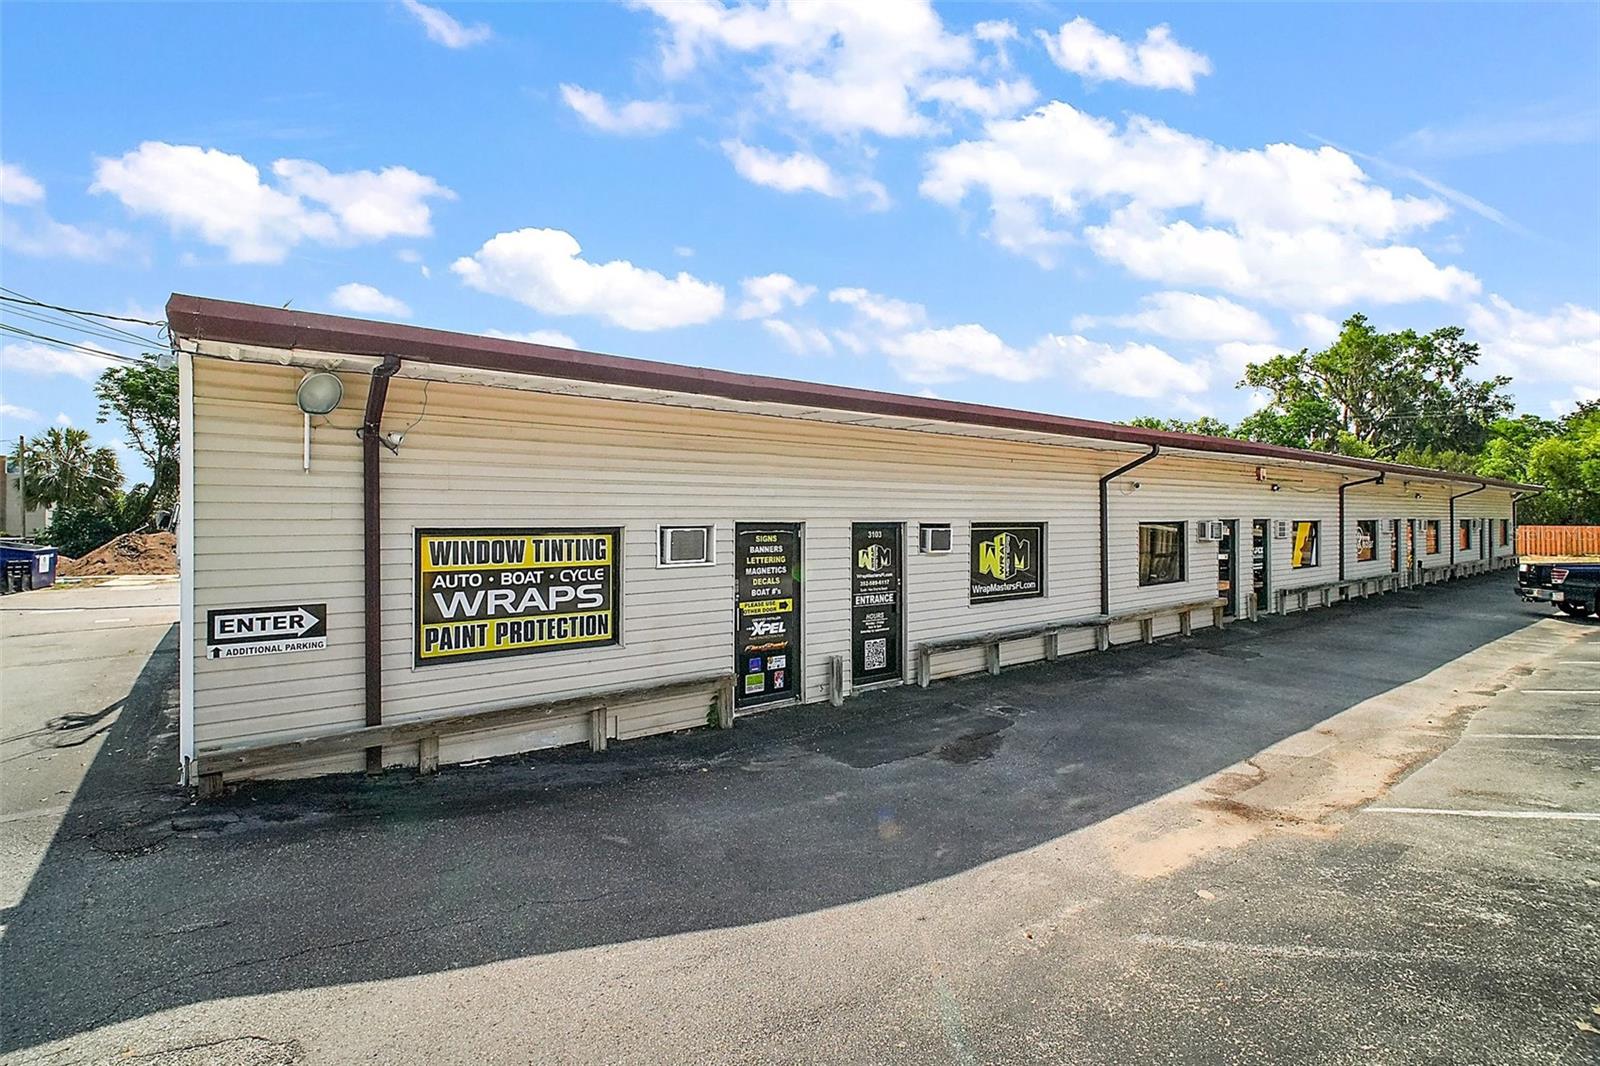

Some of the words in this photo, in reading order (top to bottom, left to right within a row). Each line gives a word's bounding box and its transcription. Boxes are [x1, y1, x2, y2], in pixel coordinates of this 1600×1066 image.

[755, 535, 777, 543] SIGNS
[429, 539, 526, 566] WINDOW
[532, 538, 607, 563] TINTING
[749, 545, 783, 553] BANNERS
[746, 555, 786, 564] LETTERING
[745, 566, 787, 575] MAGNETICS
[432, 573, 482, 589] AUTO
[500, 571, 544, 586] BOAT
[559, 568, 604, 582] CYCLE
[752, 577, 780, 586] DECALS
[751, 588, 771, 597] BOAT
[432, 584, 603, 618] WRAPS
[855, 593, 894, 605] ENTRANCE
[866, 612, 885, 620] HOURS
[220, 615, 305, 634] ENTER
[751, 621, 787, 637] XPEL
[425, 623, 489, 652] PAINT
[495, 614, 609, 645] PROTECTION
[226, 645, 282, 657] ADDITIONAL
[285, 641, 324, 652] PARKING
